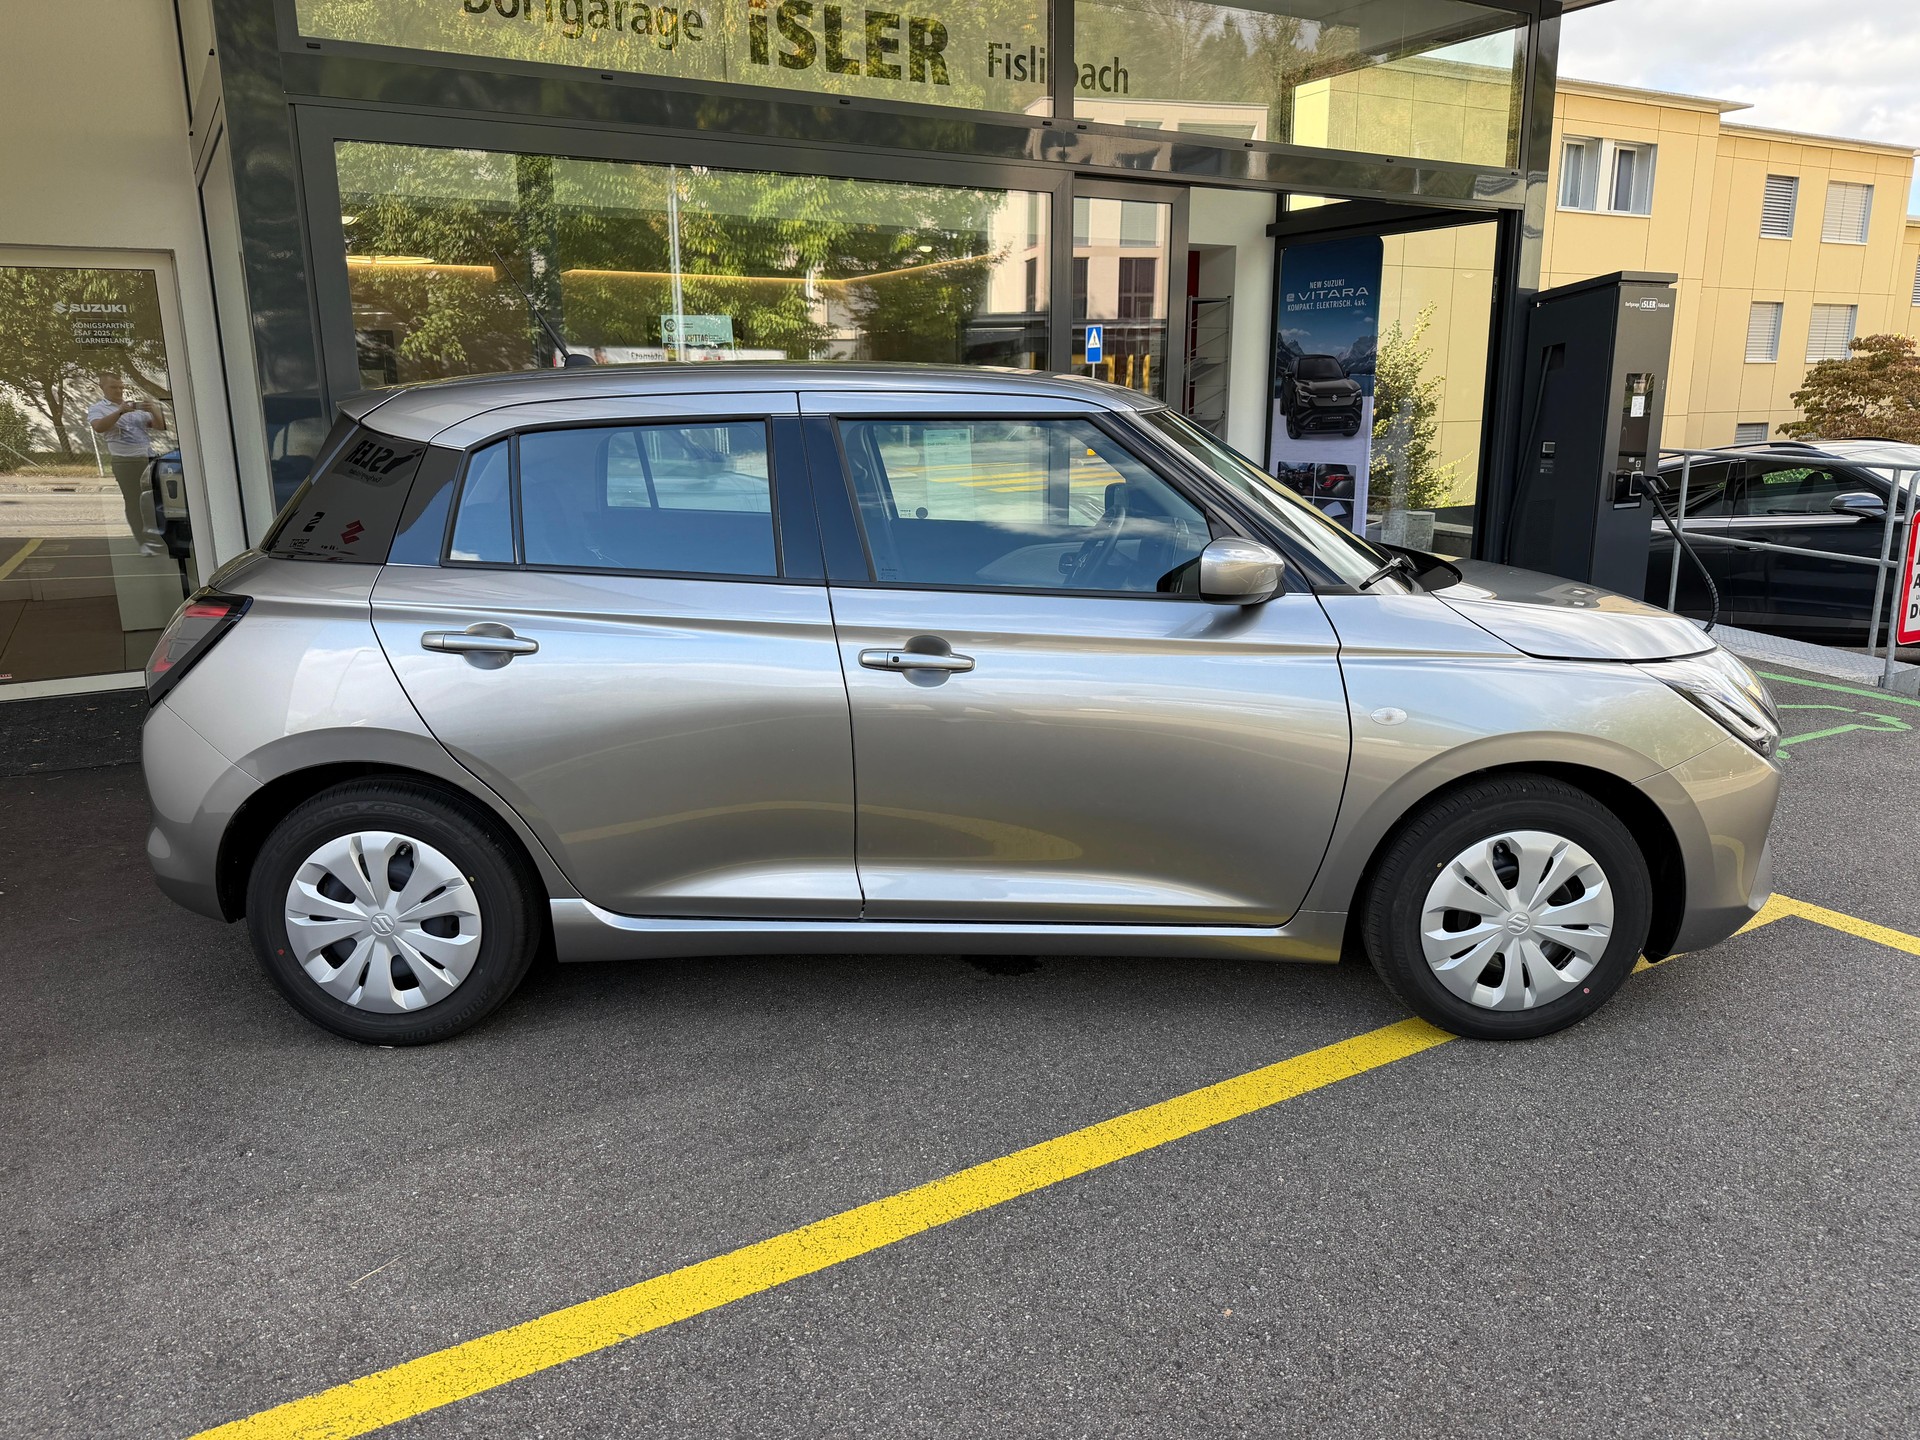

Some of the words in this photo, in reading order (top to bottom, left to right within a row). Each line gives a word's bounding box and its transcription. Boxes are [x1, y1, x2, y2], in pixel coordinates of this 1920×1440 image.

[988, 42, 1129, 94] Fisliach
[1309, 280, 1322, 289] NEW
[1323, 279, 1345, 288] SUZUKI
[1298, 287, 1369, 301] VITARA
[69, 303, 127, 313] SUZUKI
[1287, 302, 1315, 312] KOMPAKT.
[1316, 300, 1353, 309] ELEKTRISCH.
